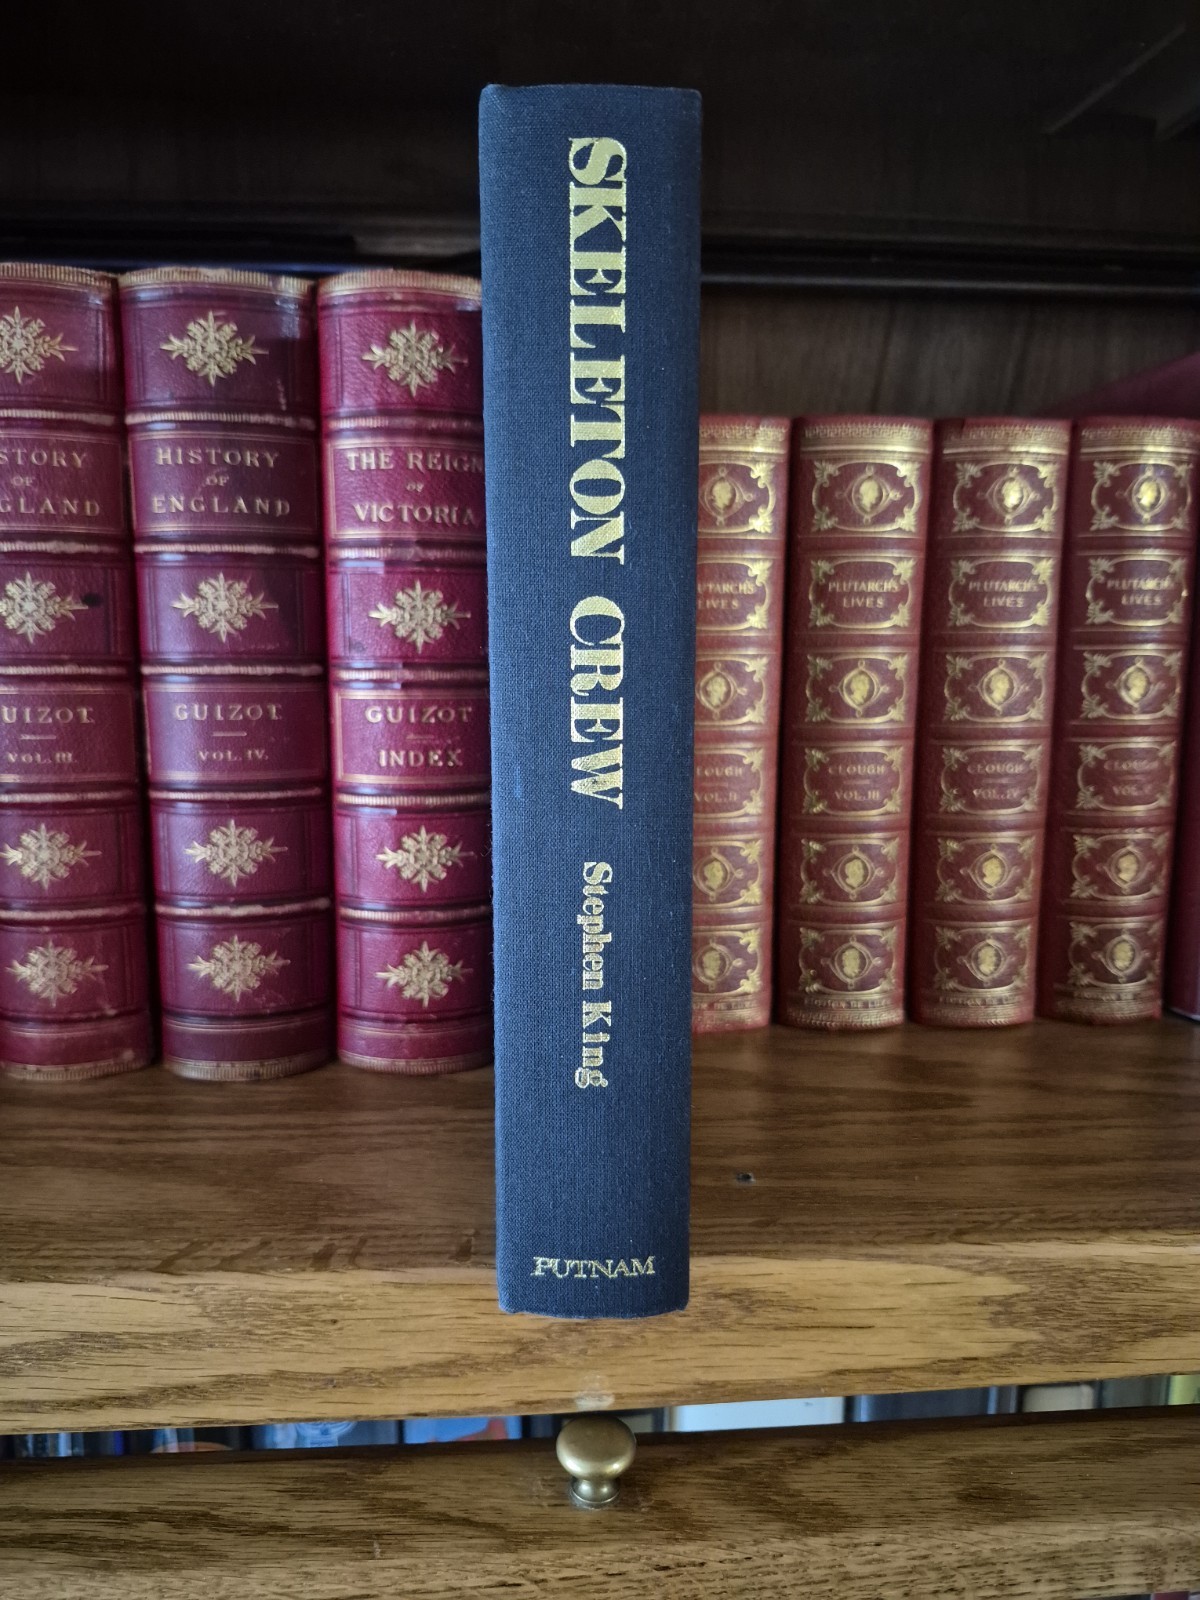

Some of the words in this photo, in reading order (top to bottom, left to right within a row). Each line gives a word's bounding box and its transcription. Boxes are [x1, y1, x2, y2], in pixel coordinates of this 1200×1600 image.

[568, 136, 627, 565] SKELETON
[155, 447, 279, 469] HISTORY
[346, 450, 395, 471] THE
[407, 450, 484, 474] REIGN
[205, 474, 230, 487] OF
[151, 495, 291, 518] ENGLAND
[353, 502, 477, 527] VICTORIA
[843, 596, 884, 609] LIVES
[983, 595, 1025, 608] LIVES
[1121, 593, 1162, 606] LIVES
[174, 703, 283, 720] GUIZOT
[568, 595, 626, 810] CREW
[364, 705, 473, 723] GUIZOT
[378, 749, 463, 767] INDEX
[828, 764, 885, 775] CLOUGH
[576, 861, 613, 991] Stephen
[574, 1000, 612, 1089] King
[530, 1255, 656, 1279] PUTNAM
